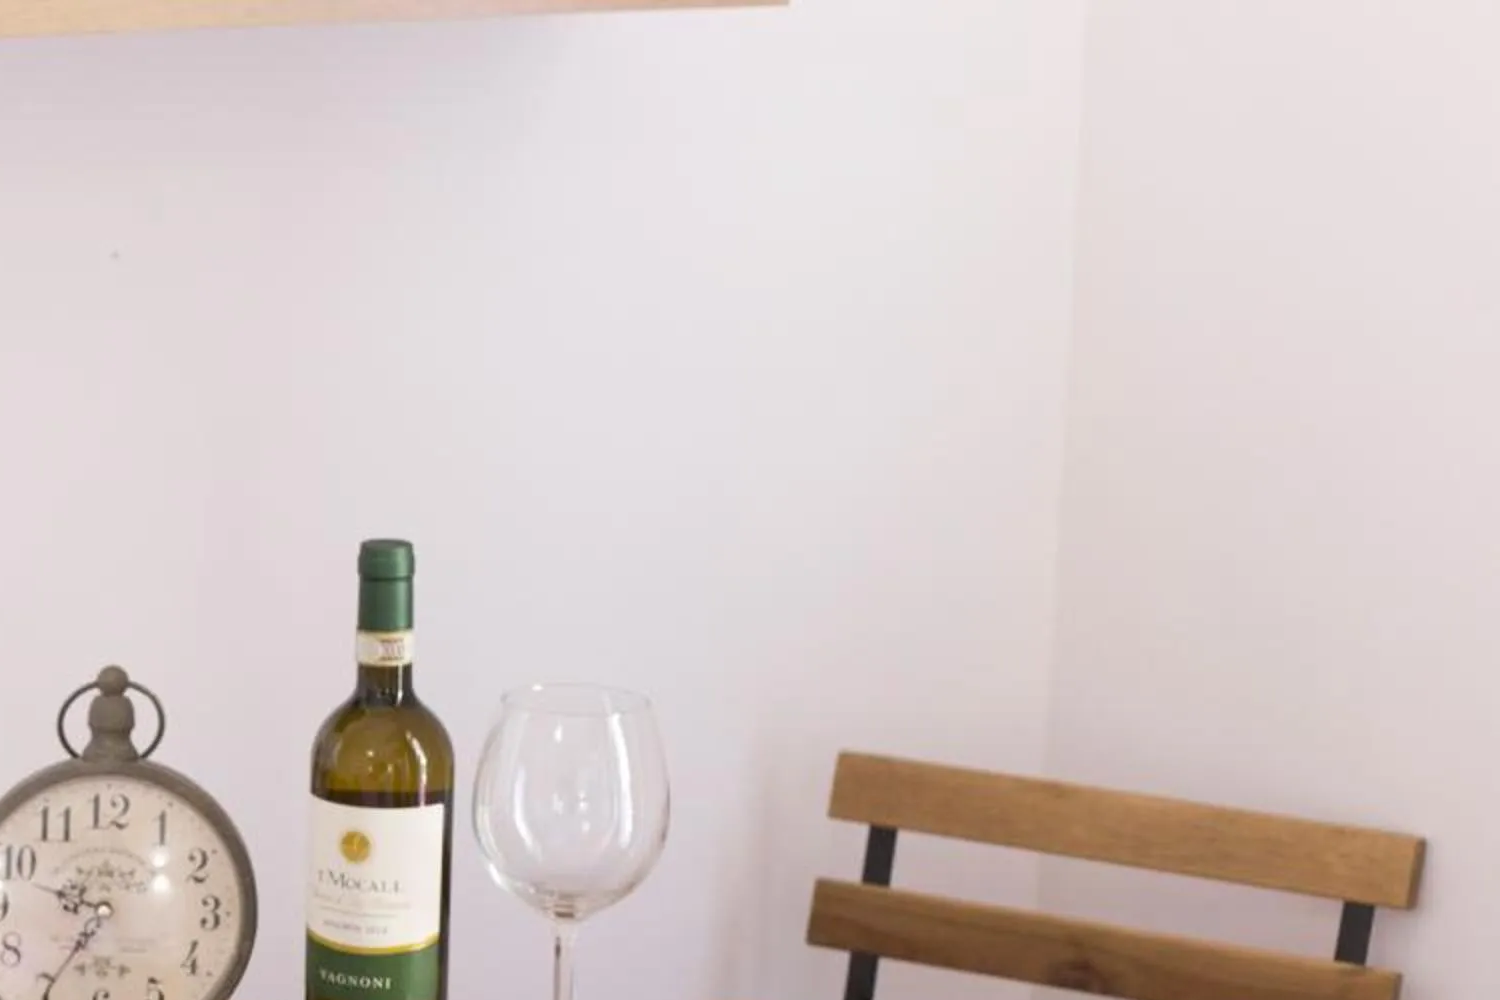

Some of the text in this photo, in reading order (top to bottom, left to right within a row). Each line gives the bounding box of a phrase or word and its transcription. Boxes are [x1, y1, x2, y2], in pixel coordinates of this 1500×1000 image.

[36, 805, 72, 843] 11
[88, 793, 131, 831] 12
[156, 809, 168, 847] 1
[3, 844, 37, 881] 10
[186, 848, 210, 884] 2
[200, 894, 222, 932] 3
[0, 931, 22, 968] 8
[180, 939, 199, 977] 4
[319, 967, 392, 990] VAGNONI
